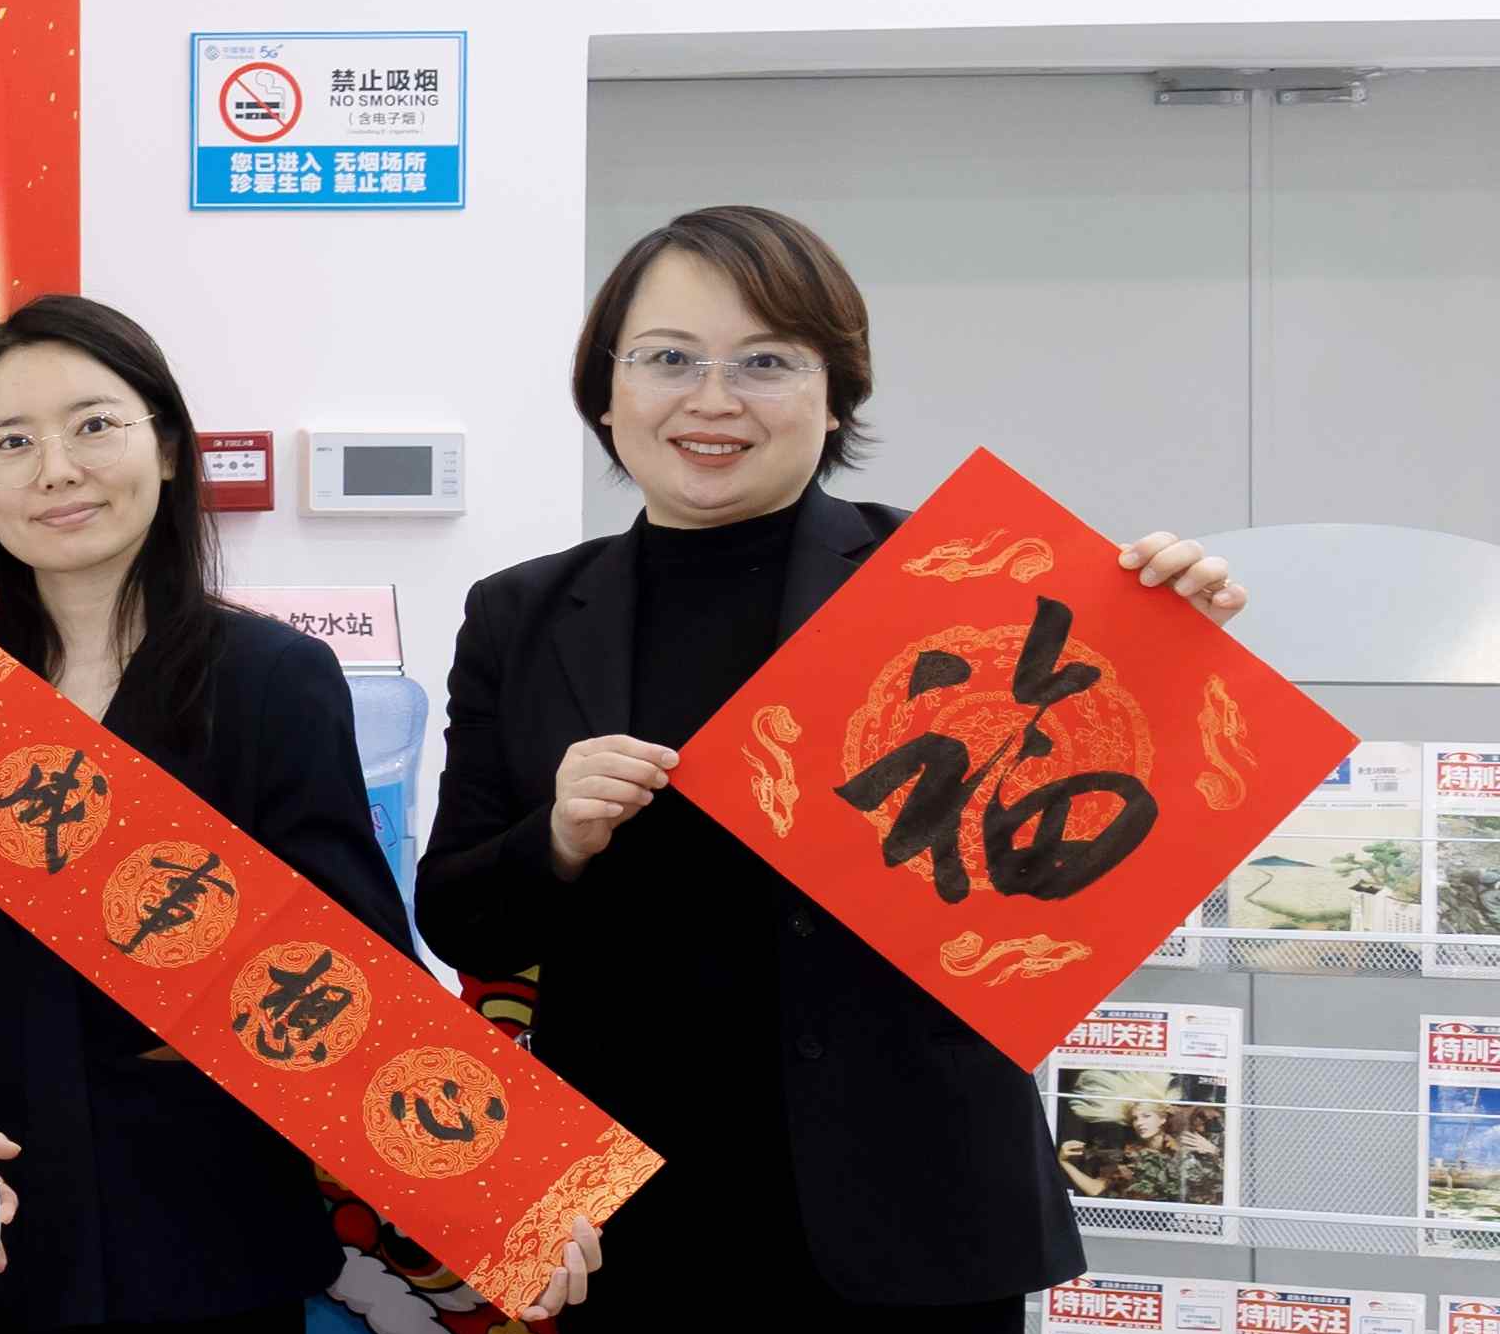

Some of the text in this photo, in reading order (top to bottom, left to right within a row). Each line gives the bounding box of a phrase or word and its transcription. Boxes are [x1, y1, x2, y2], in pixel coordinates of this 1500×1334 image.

[331, 69, 439, 94] 禁止吸烟
[330, 94, 440, 107] NO SMOKING
[230, 151, 427, 172] 您已进入 无烟场所
[230, 173, 427, 194] 珍爱生命 禁止烟草
[268, 612, 373, 637] 饮水站
[833, 595, 1159, 905] 福
[1440, 766, 1500, 790] 特别
[1052, 1289, 1159, 1320] 特别关注
[1237, 1302, 1347, 1334] 特别关注
